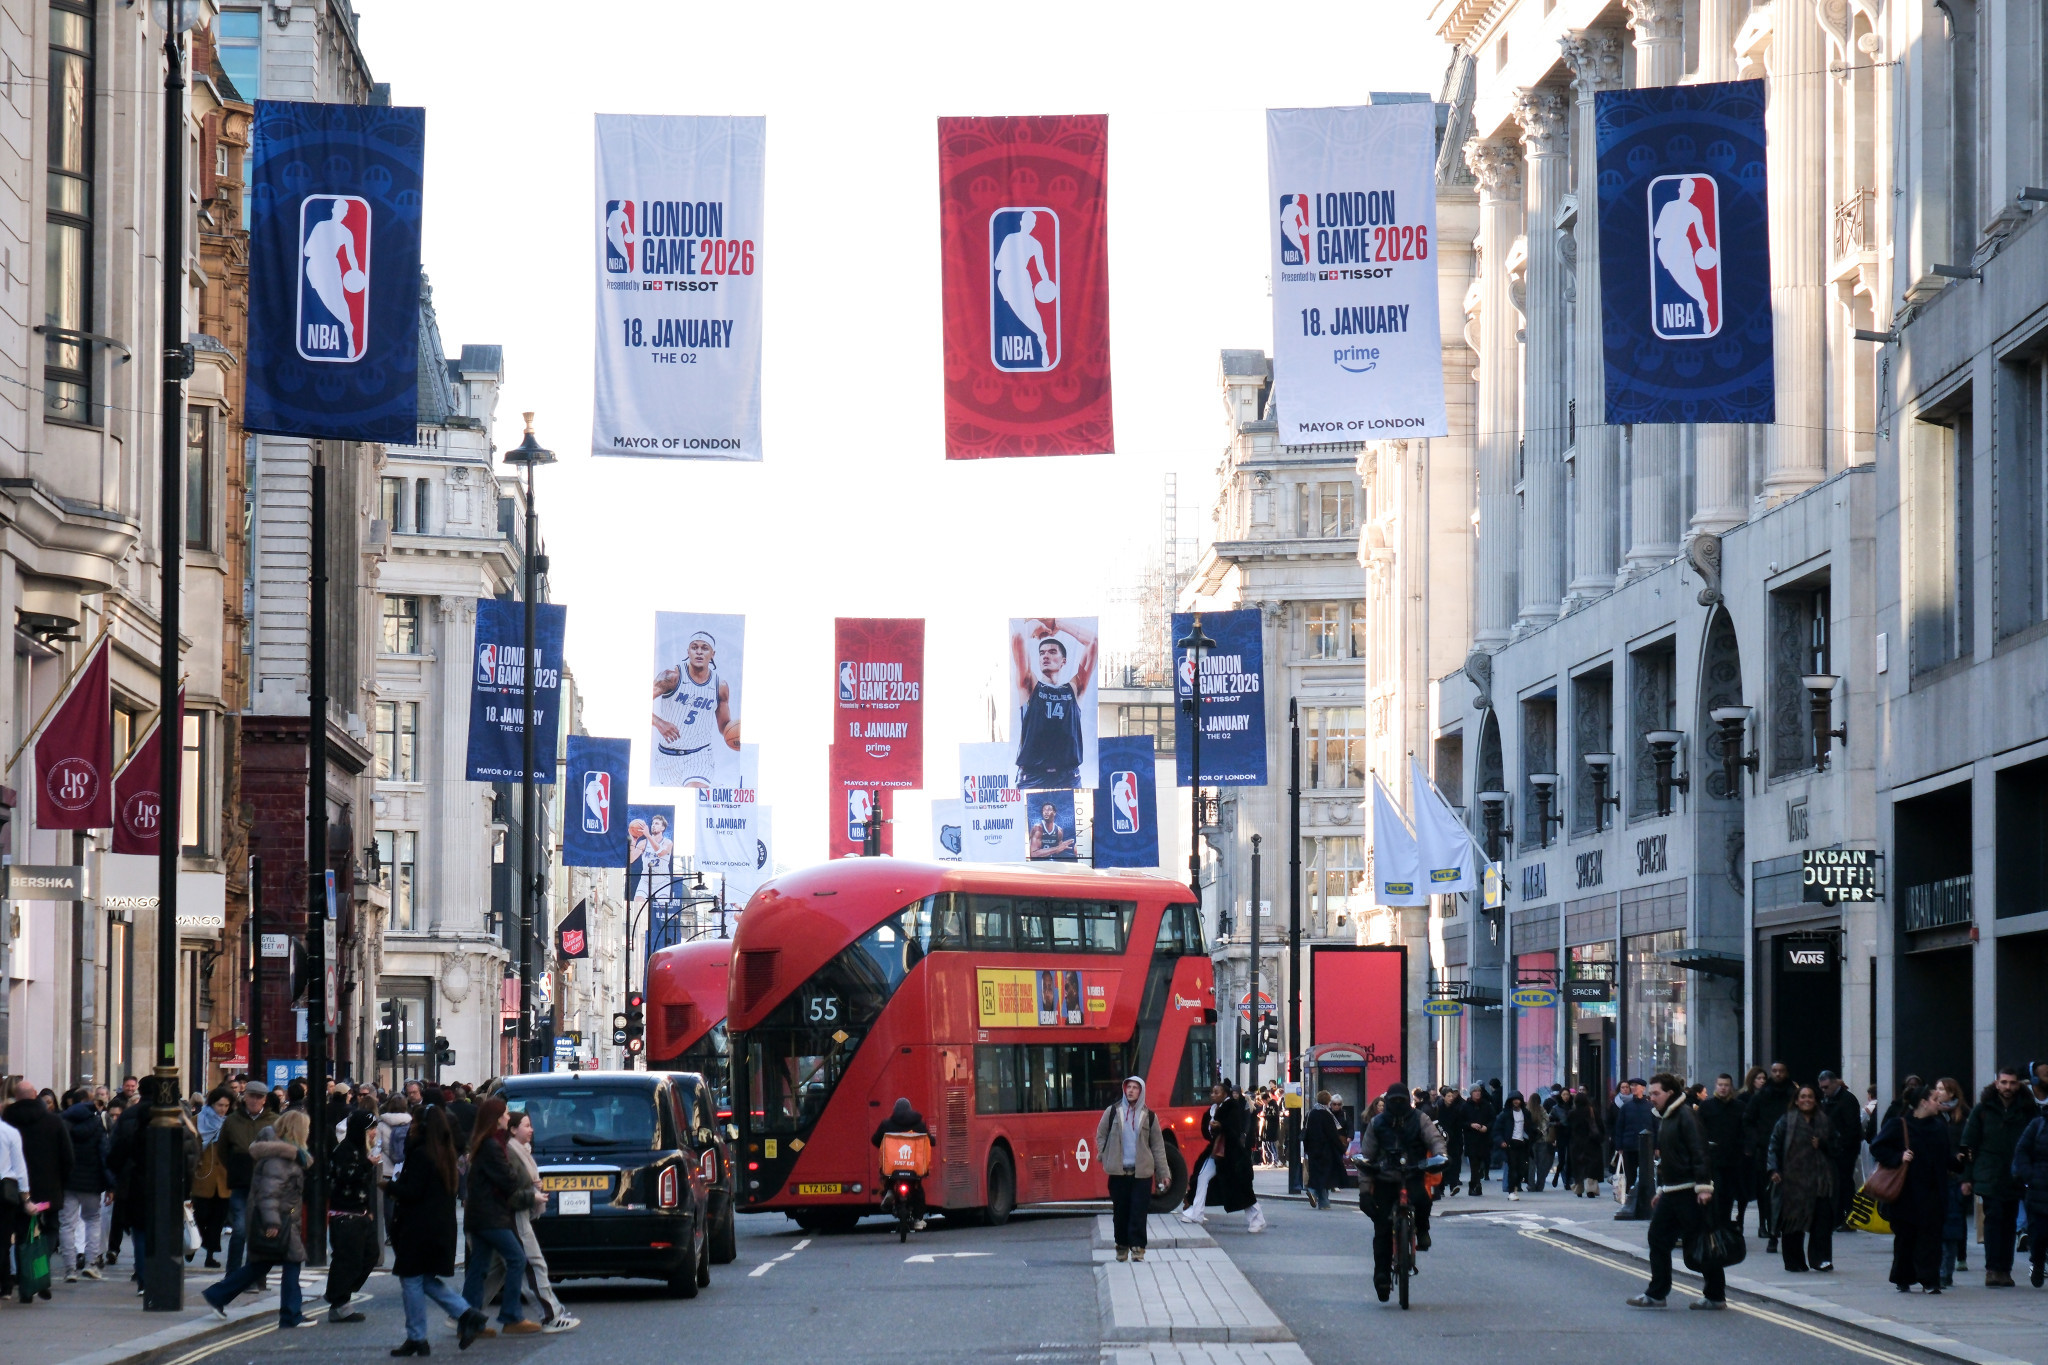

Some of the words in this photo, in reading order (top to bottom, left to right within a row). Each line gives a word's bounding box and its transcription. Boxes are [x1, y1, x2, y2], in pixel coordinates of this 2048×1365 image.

[1316, 190, 1395, 226] LONDON
[642, 201, 723, 238] LONDON
[1317, 228, 1370, 263] GAME
[1374, 225, 1428, 262] 2026
[642, 239, 695, 275] GAME
[701, 240, 755, 275] 2026
[1281, 271, 1308, 283] Presented
[1309, 271, 1316, 282] by
[1340, 268, 1393, 280] TISSOT
[606, 279, 633, 290] Presented
[633, 282, 640, 292] by
[664, 282, 718, 291] TISSOT
[1301, 308, 1327, 336] 18.
[1330, 304, 1410, 335] JANUARY
[1663, 303, 1695, 328] NBA
[307, 324, 341, 350] NBA
[623, 319, 647, 348] 18.
[651, 320, 733, 348] JANUARY
[1001, 335, 1035, 361] NBA
[1334, 346, 1380, 365] prime
[651, 353, 676, 364] THE
[1299, 420, 1343, 432] MAYOR
[1347, 420, 1364, 430] OF
[1368, 417, 1425, 429] LONDON
[613, 437, 658, 449] MAYOR
[661, 439, 680, 449] OF
[683, 439, 741, 450] LONDON
[499, 646, 541, 668] LONDN
[534, 669, 557, 688] 026
[860, 663, 902, 681] LONDON
[860, 682, 888, 700] GAME
[890, 682, 919, 700] 2026
[1230, 673, 1259, 693] 2026
[486, 706, 498, 721] 18.
[500, 708, 544, 725] JANURY
[684, 710, 698, 725] 5
[1046, 701, 1064, 719] 14
[850, 722, 862, 738] 18.
[865, 722, 908, 738] JANUARY
[1206, 715, 1249, 731] JANUARY
[866, 743, 891, 753] prime
[978, 775, 1008, 789] LONDON
[713, 789, 732, 802] GAME
[734, 789, 754, 802] 2026
[979, 789, 999, 803] GAME
[1001, 789, 1021, 802] 2026
[706, 818, 714, 828] 18.
[716, 819, 746, 829] JANUARY
[972, 820, 981, 830] 18.
[983, 819, 1014, 830] JANUARY
[1117, 819, 1129, 830] NBA
[1787, 795, 1808, 842] VANS
[11, 878, 73, 888] BERSHKA
[1434, 871, 1459, 879] IKEA
[1523, 862, 1547, 901] IKEA
[106, 897, 160, 907] MANGO
[1789, 951, 1824, 964] VANS
[810, 998, 837, 1020] 55
[1366, 1054, 1396, 1064] Dept.
[546, 1177, 577, 1188] LF23
[581, 1177, 603, 1188] WAC
